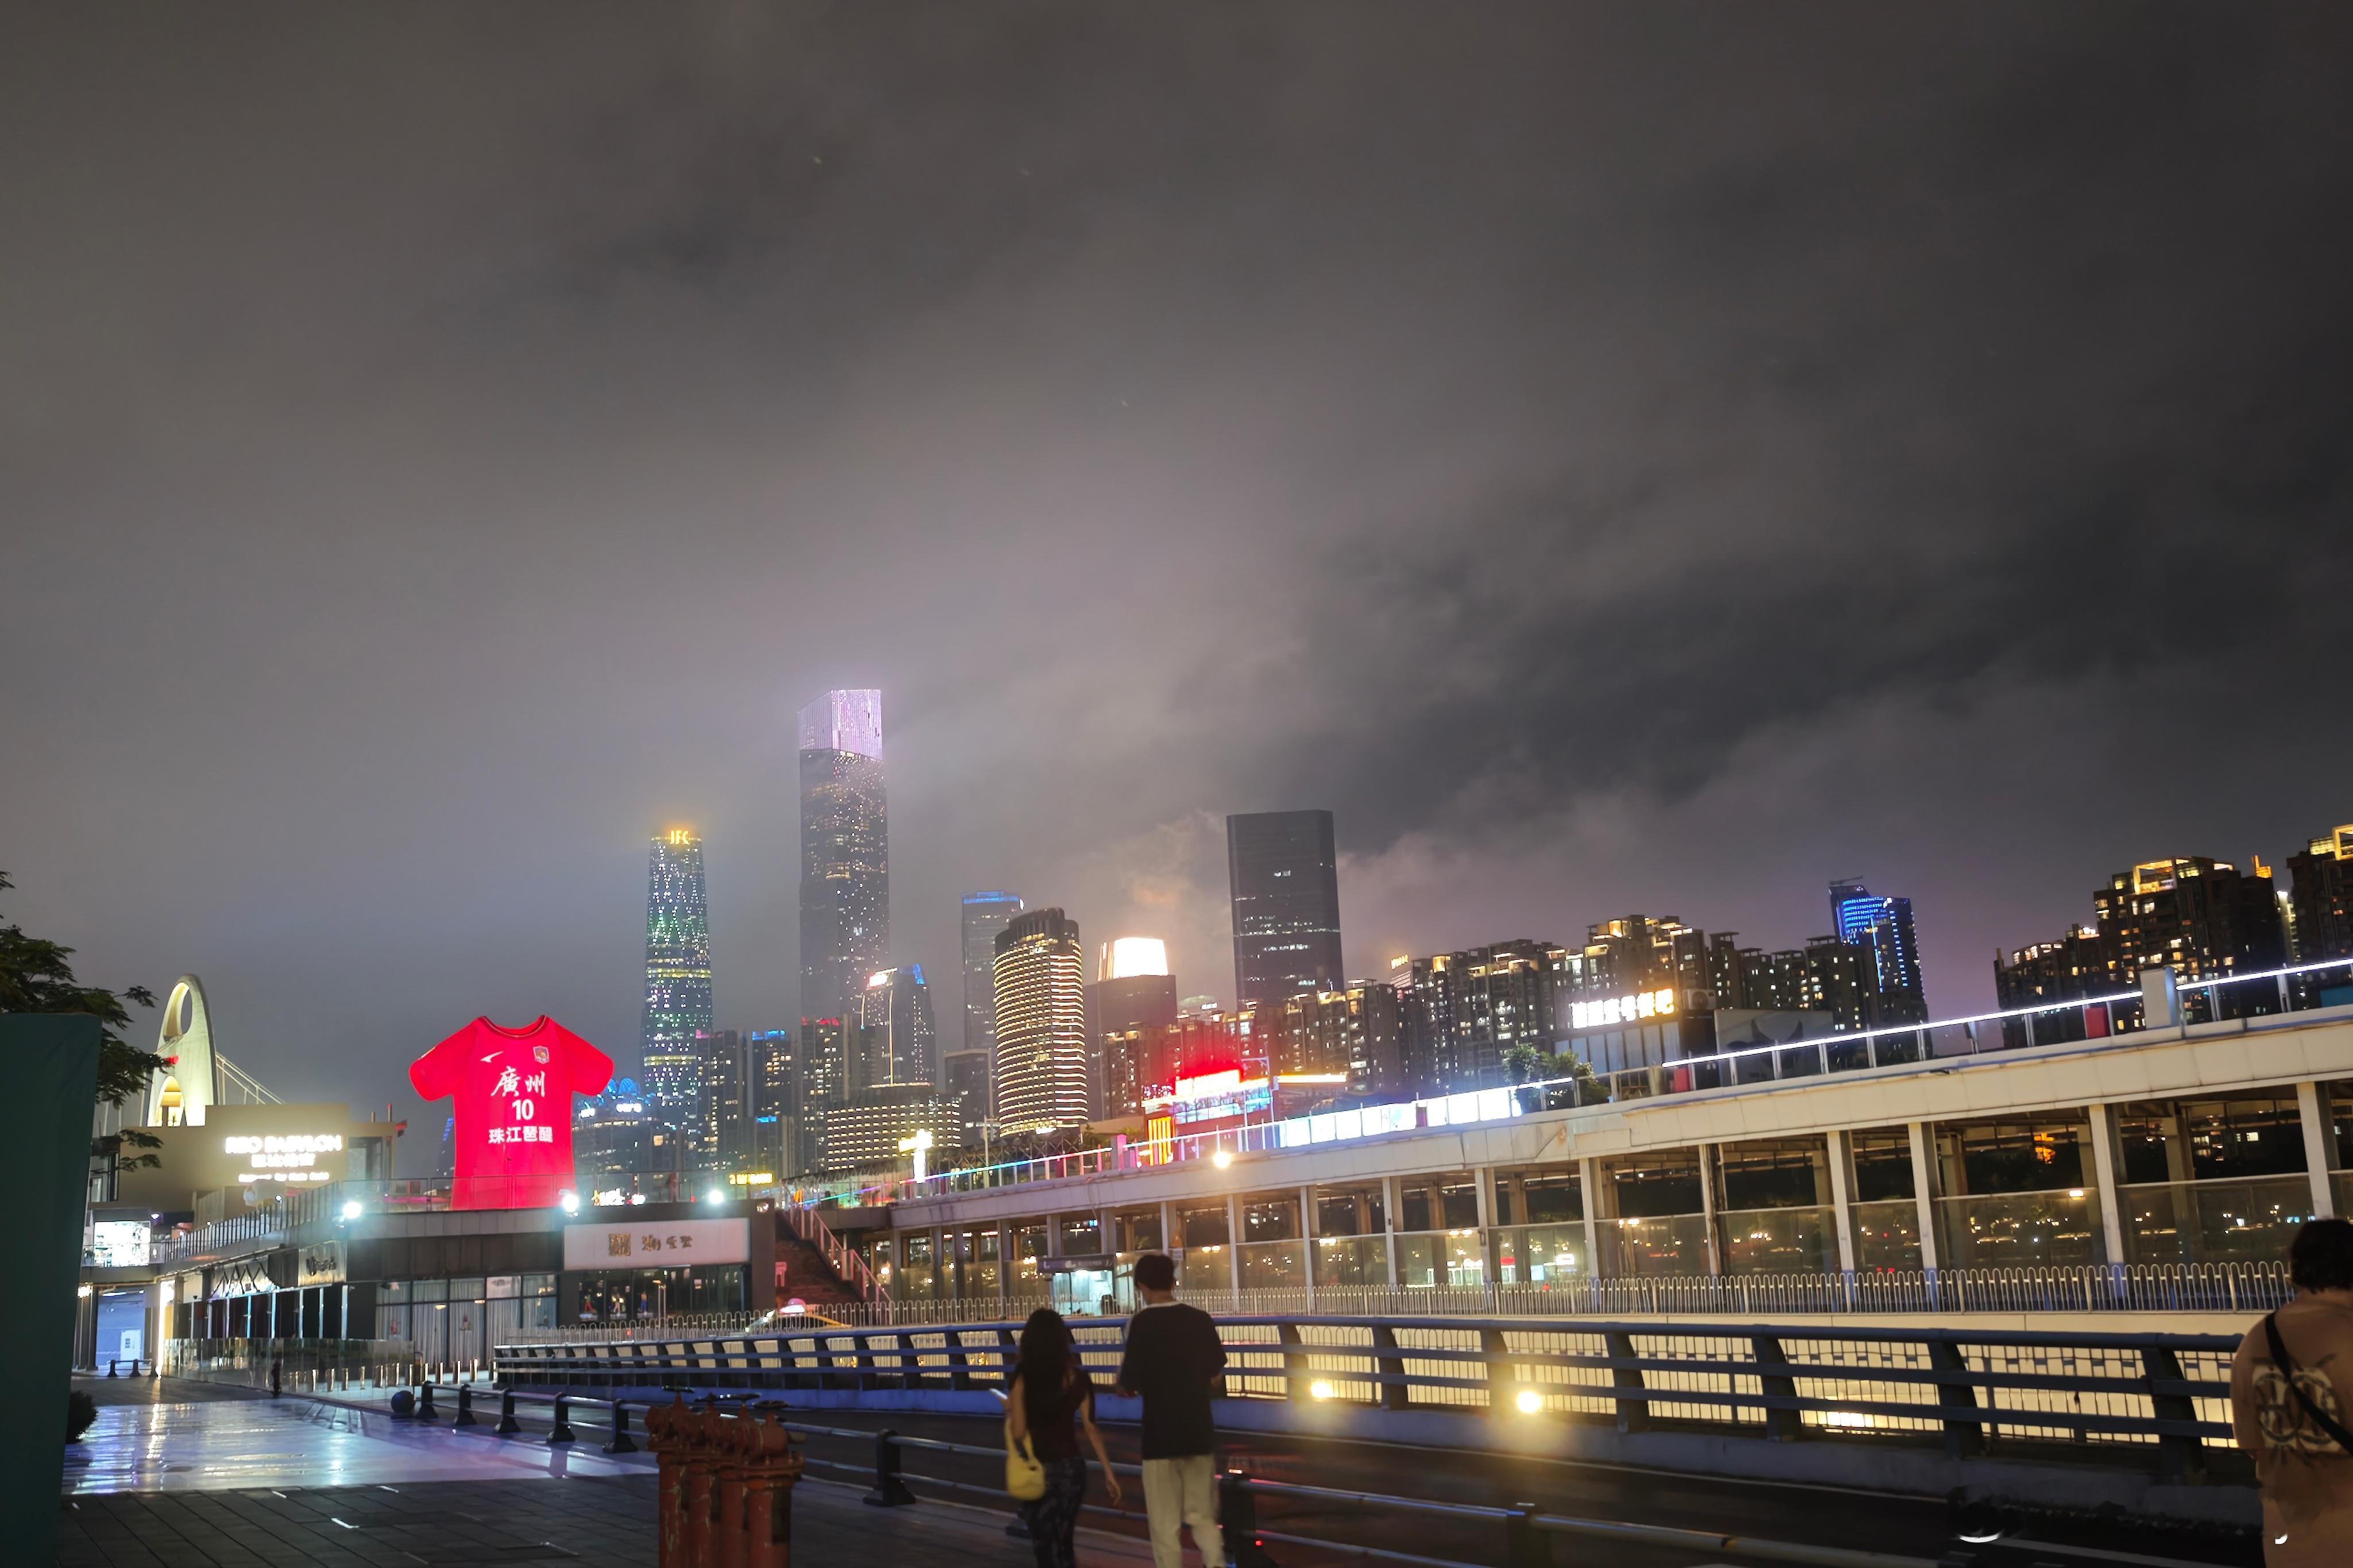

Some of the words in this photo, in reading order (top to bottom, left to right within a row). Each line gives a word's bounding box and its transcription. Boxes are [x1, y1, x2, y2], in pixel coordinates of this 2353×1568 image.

[670, 830, 689, 845] IFC
[491, 1065, 545, 1097] 廣州
[512, 1099, 534, 1121] 10
[488, 1125, 553, 1144] 珠江琶醍
